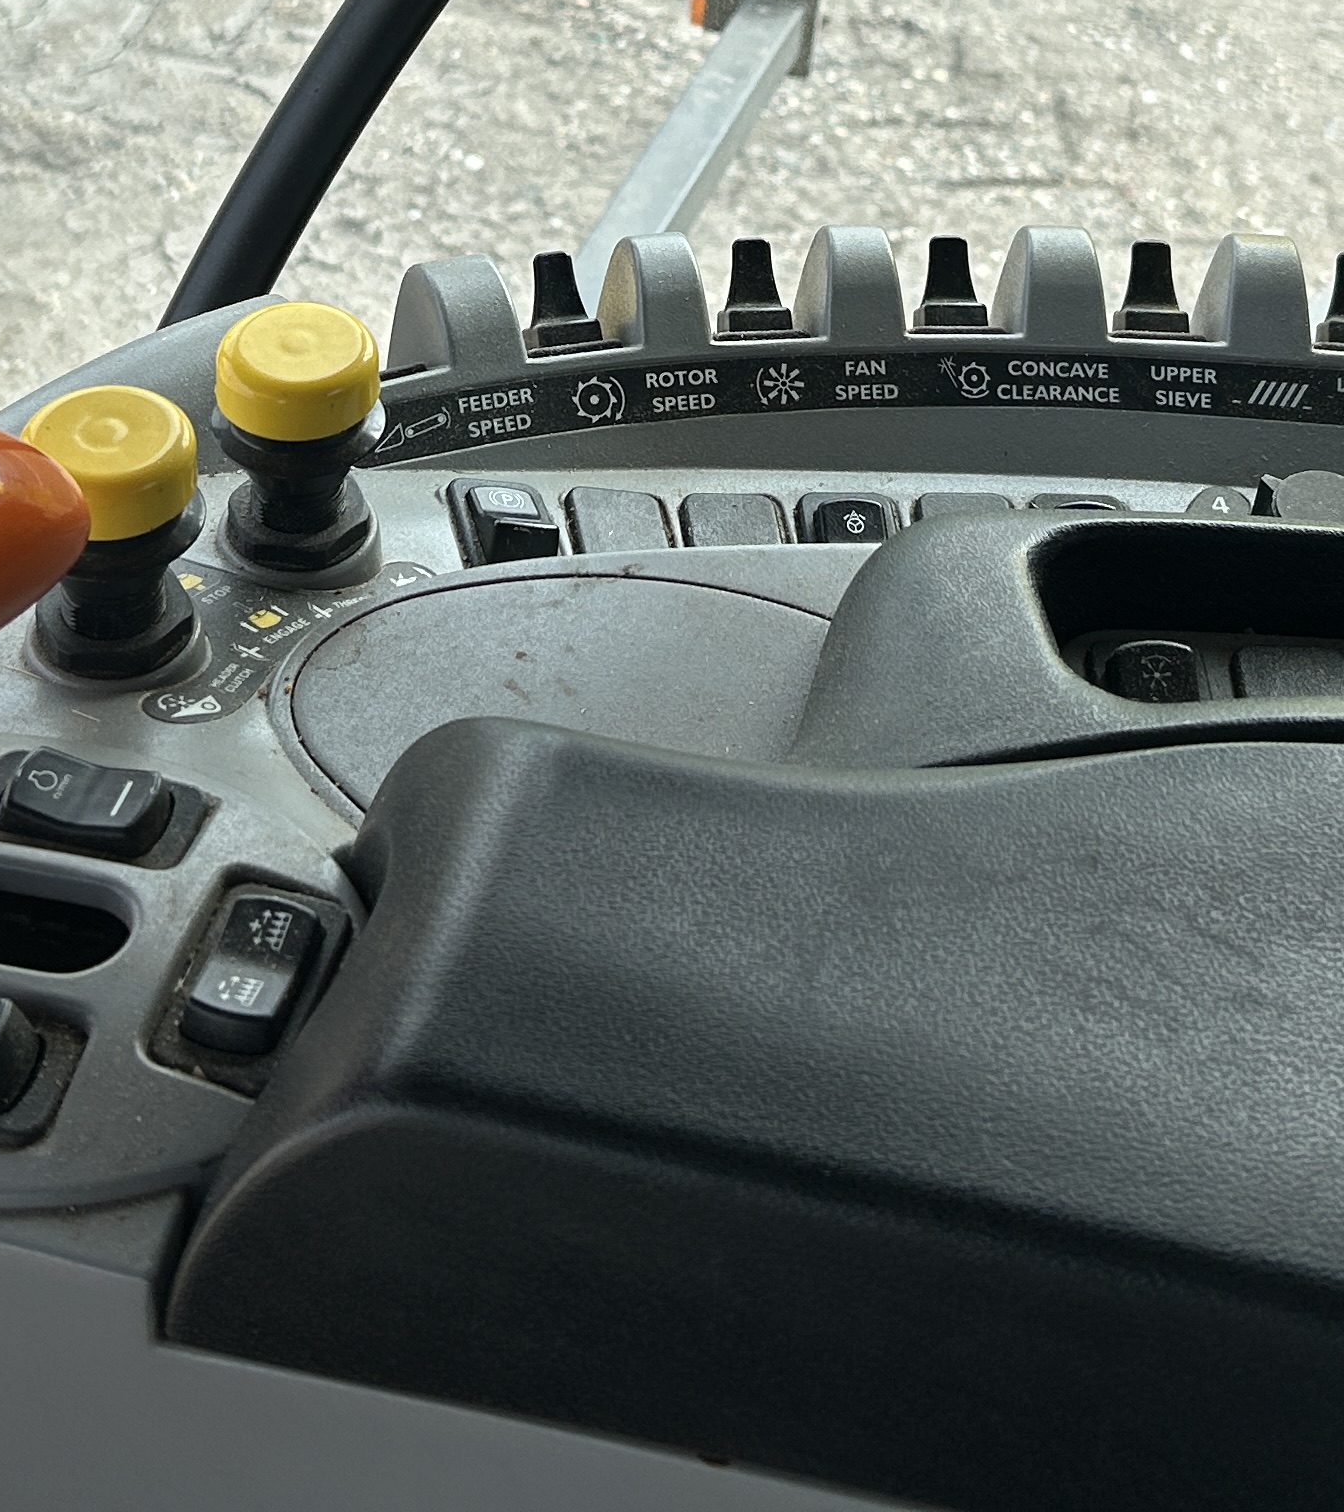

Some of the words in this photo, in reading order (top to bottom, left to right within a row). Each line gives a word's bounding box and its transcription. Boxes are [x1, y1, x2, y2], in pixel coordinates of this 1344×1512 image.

[646, 368, 719, 387] ROTOR
[845, 359, 887, 377] FAN
[1007, 359, 1110, 381] CONCAVE
[1150, 365, 1218, 385] UPPER
[458, 387, 534, 413] FEEDER
[835, 382, 899, 402] SPEED
[996, 383, 1121, 404] CLEARANCE
[1155, 389, 1212, 409] SIEVE
[652, 393, 716, 413] SPEED
[469, 414, 532, 440] SPEED
[1211, 496, 1231, 514] 4
[201, 585, 231, 606] STOP
[263, 617, 312, 645] ENGAGE
